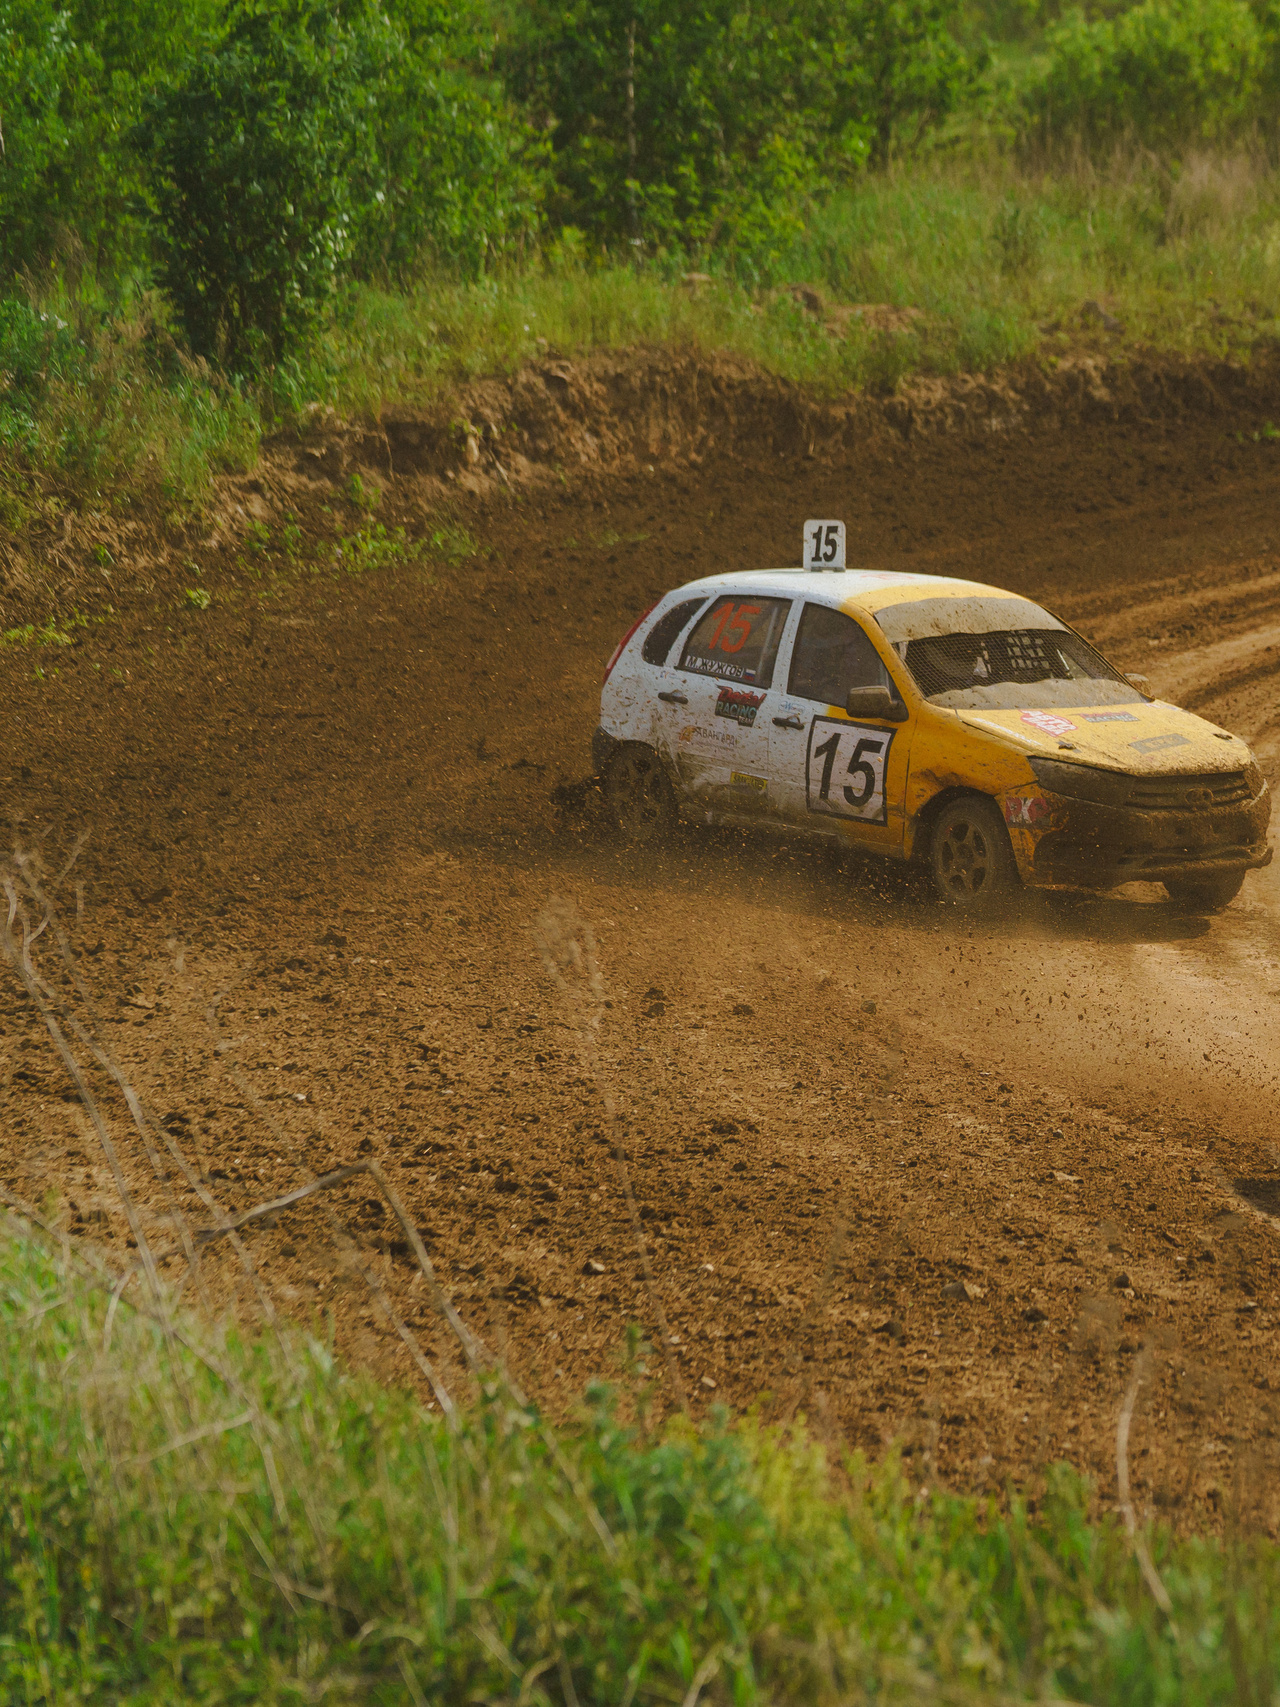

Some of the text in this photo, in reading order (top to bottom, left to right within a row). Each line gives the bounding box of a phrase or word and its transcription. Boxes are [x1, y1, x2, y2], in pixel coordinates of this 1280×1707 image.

[811, 525, 839, 562] 15
[708, 602, 762, 653] 15
[717, 701, 757, 719] RACING
[814, 733, 884, 807] 15
